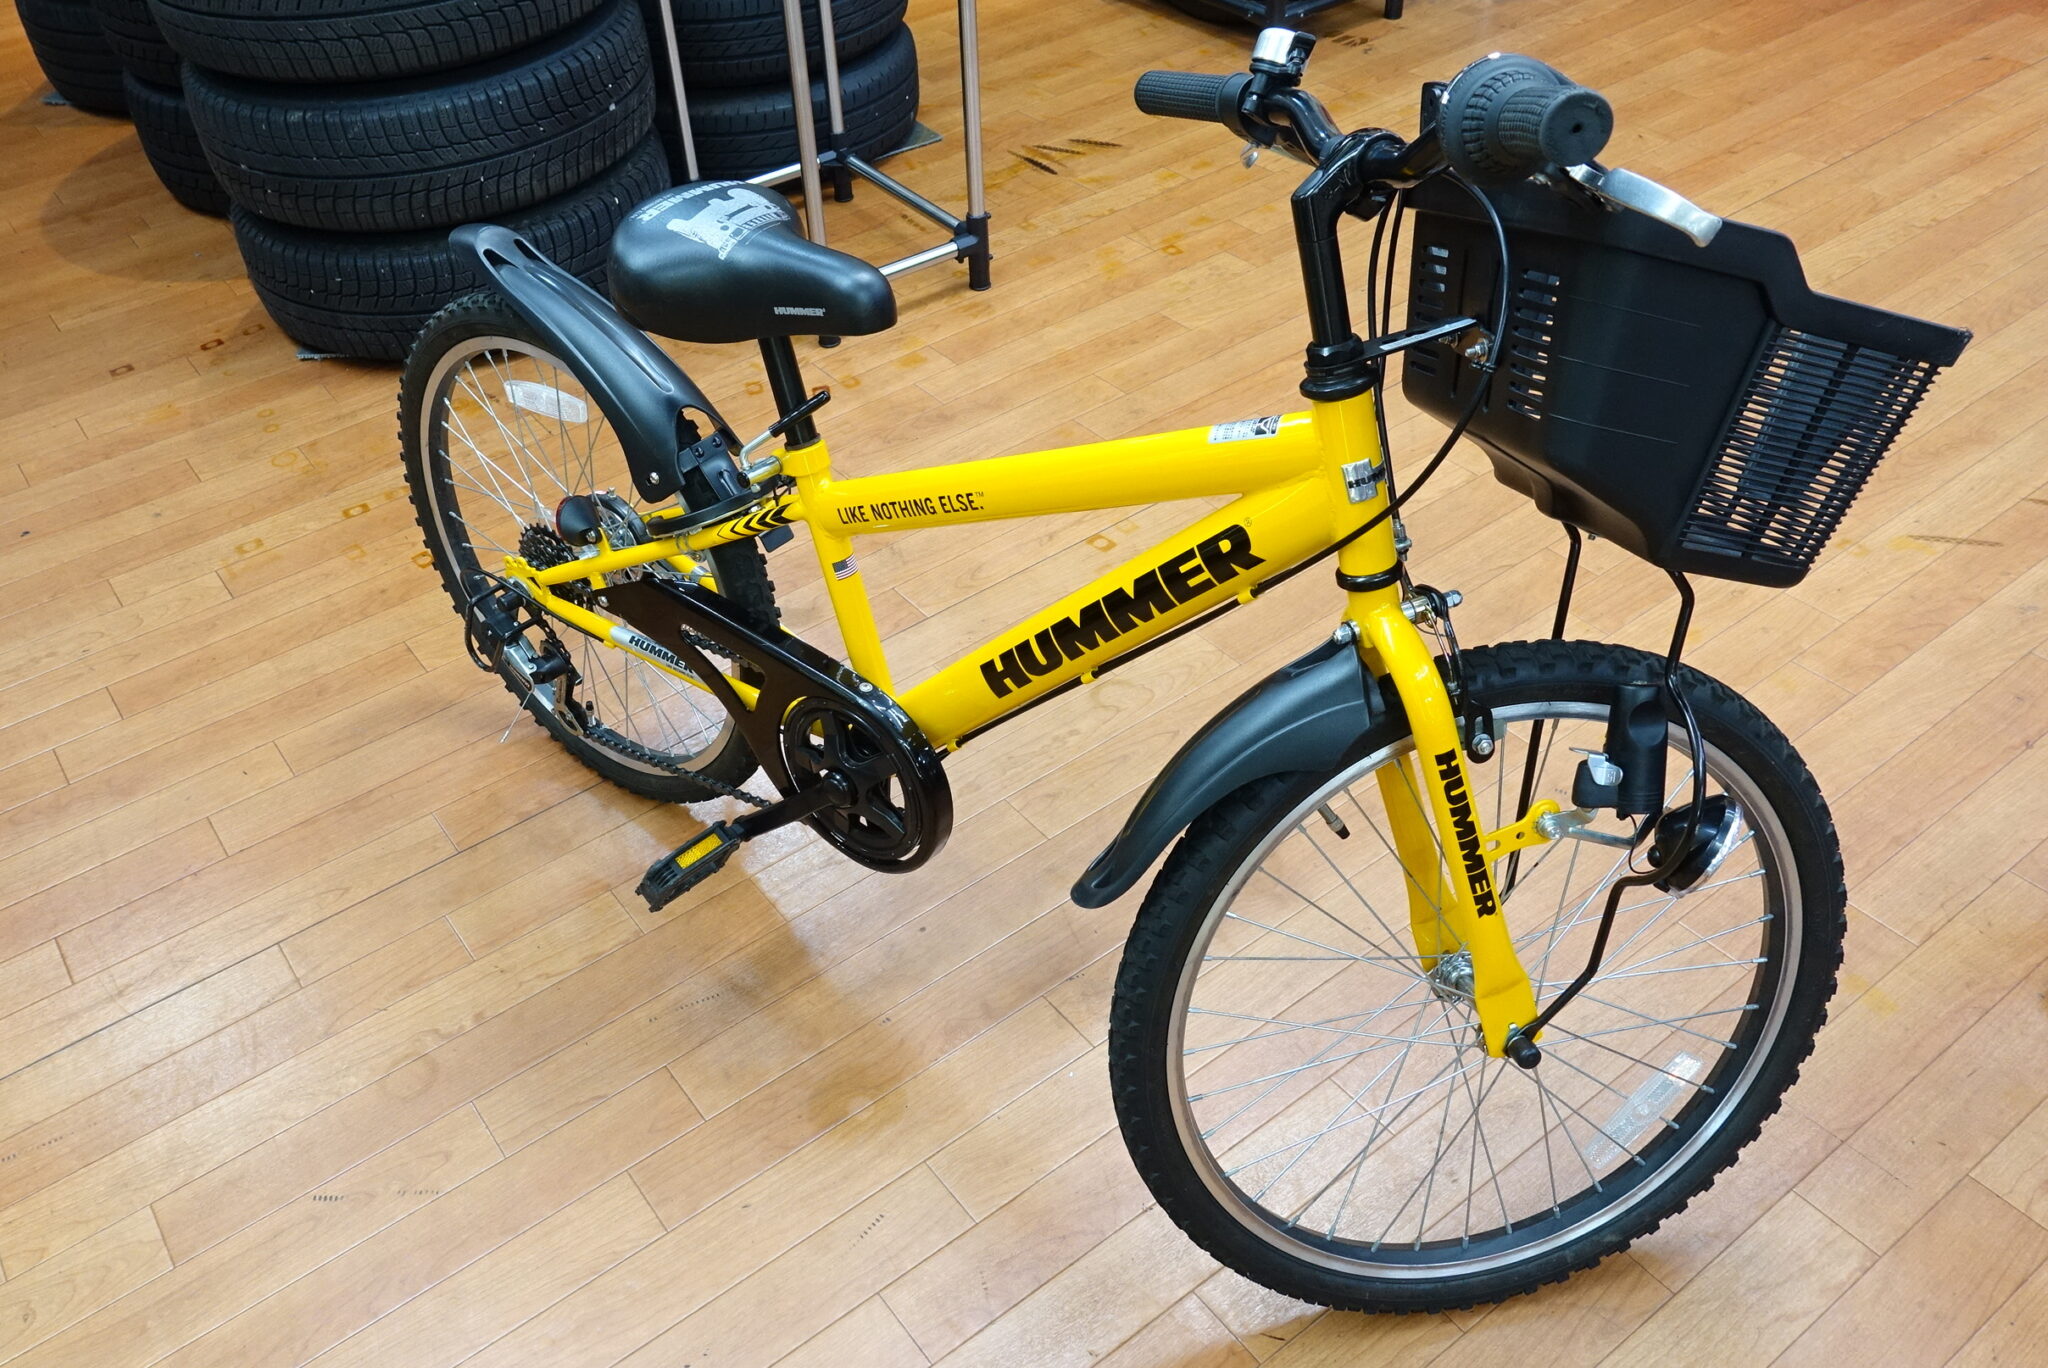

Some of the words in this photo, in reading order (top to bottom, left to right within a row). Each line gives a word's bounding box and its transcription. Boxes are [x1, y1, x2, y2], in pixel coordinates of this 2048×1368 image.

[837, 505, 869, 524] LIKE
[870, 497, 937, 521] NOTHING
[979, 524, 1266, 699] HUMMER
[1434, 748, 1497, 918] HUMMER
